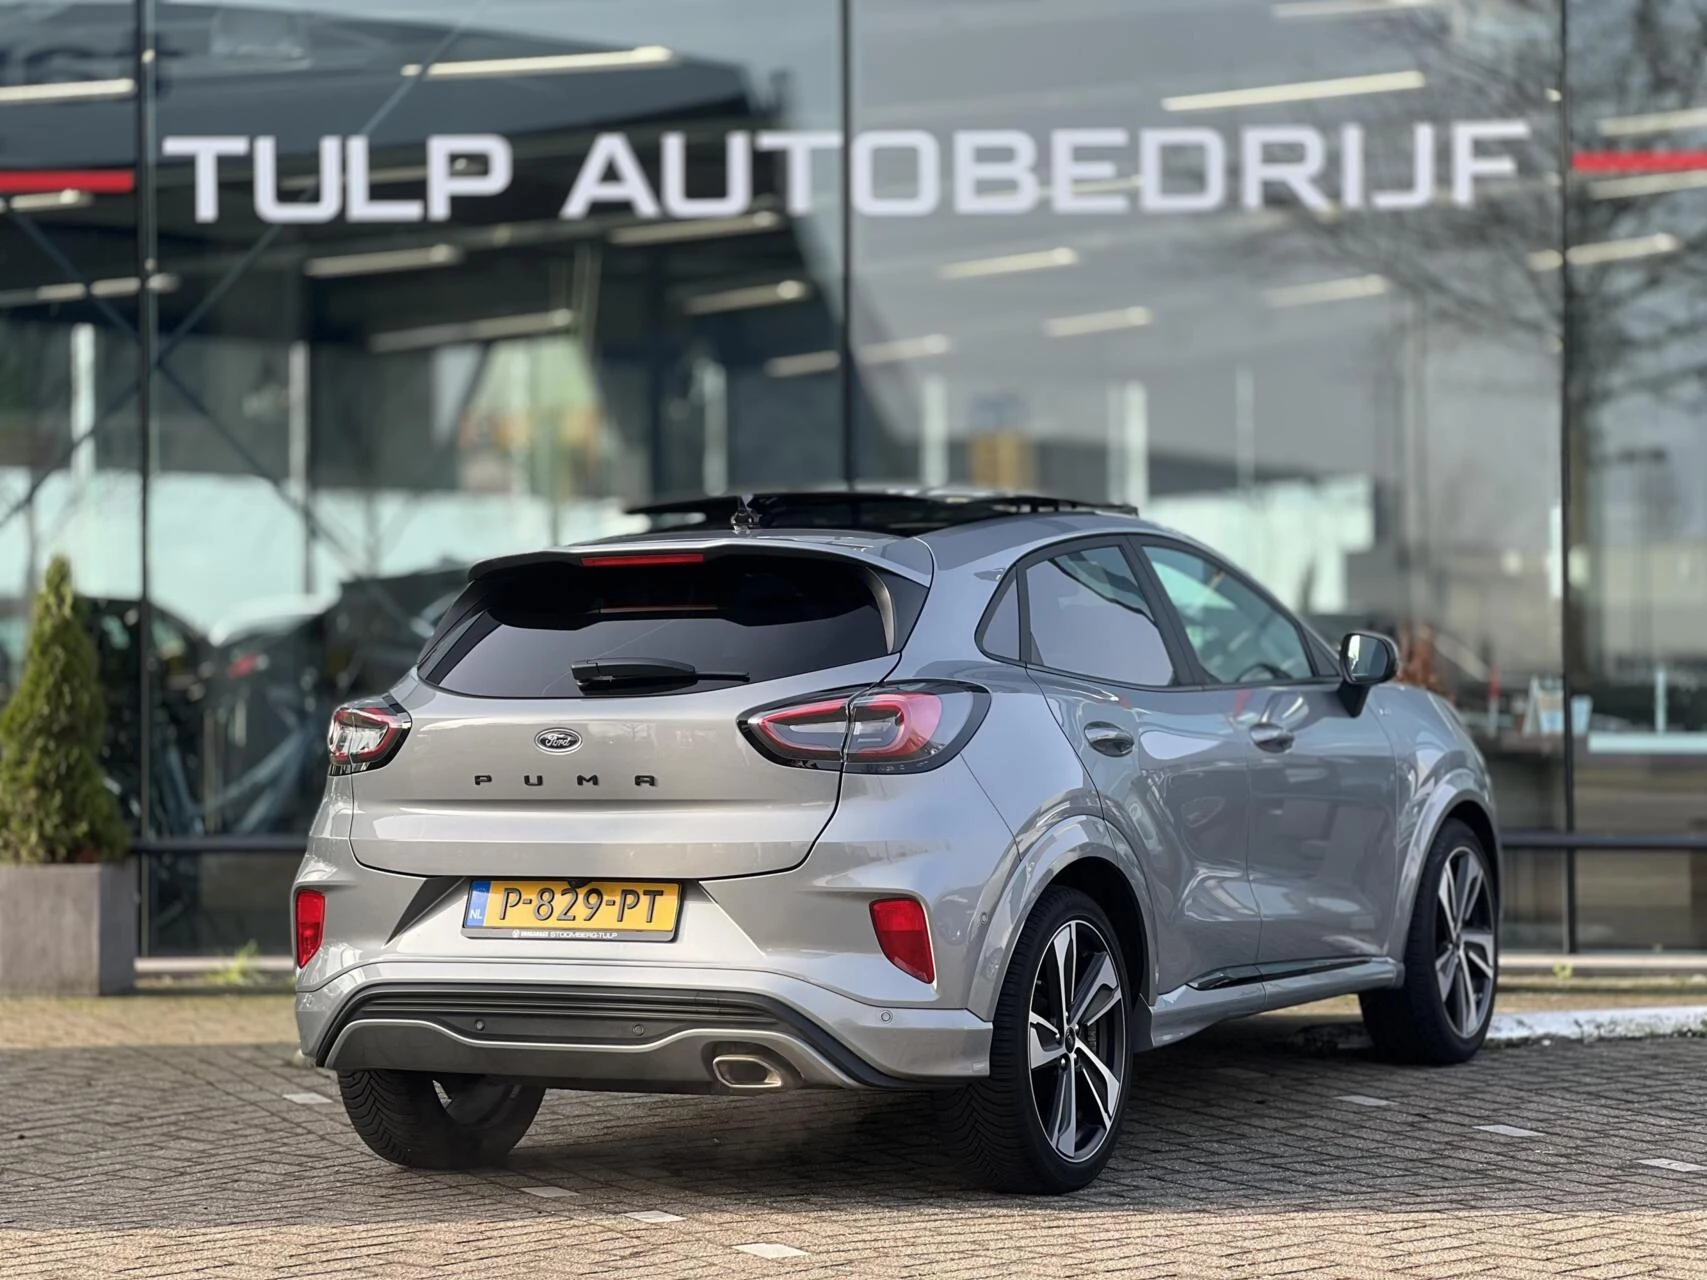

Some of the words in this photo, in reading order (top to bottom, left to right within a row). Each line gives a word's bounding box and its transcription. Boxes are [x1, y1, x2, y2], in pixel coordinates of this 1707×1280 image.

[161, 133, 514, 223] TULP
[558, 128, 1529, 220] AUTOBEDRIJF
[545, 733, 571, 747] Ford
[474, 774, 656, 787] PUMA
[500, 887, 664, 923] P-829-PT
[469, 909, 483, 920] NL
